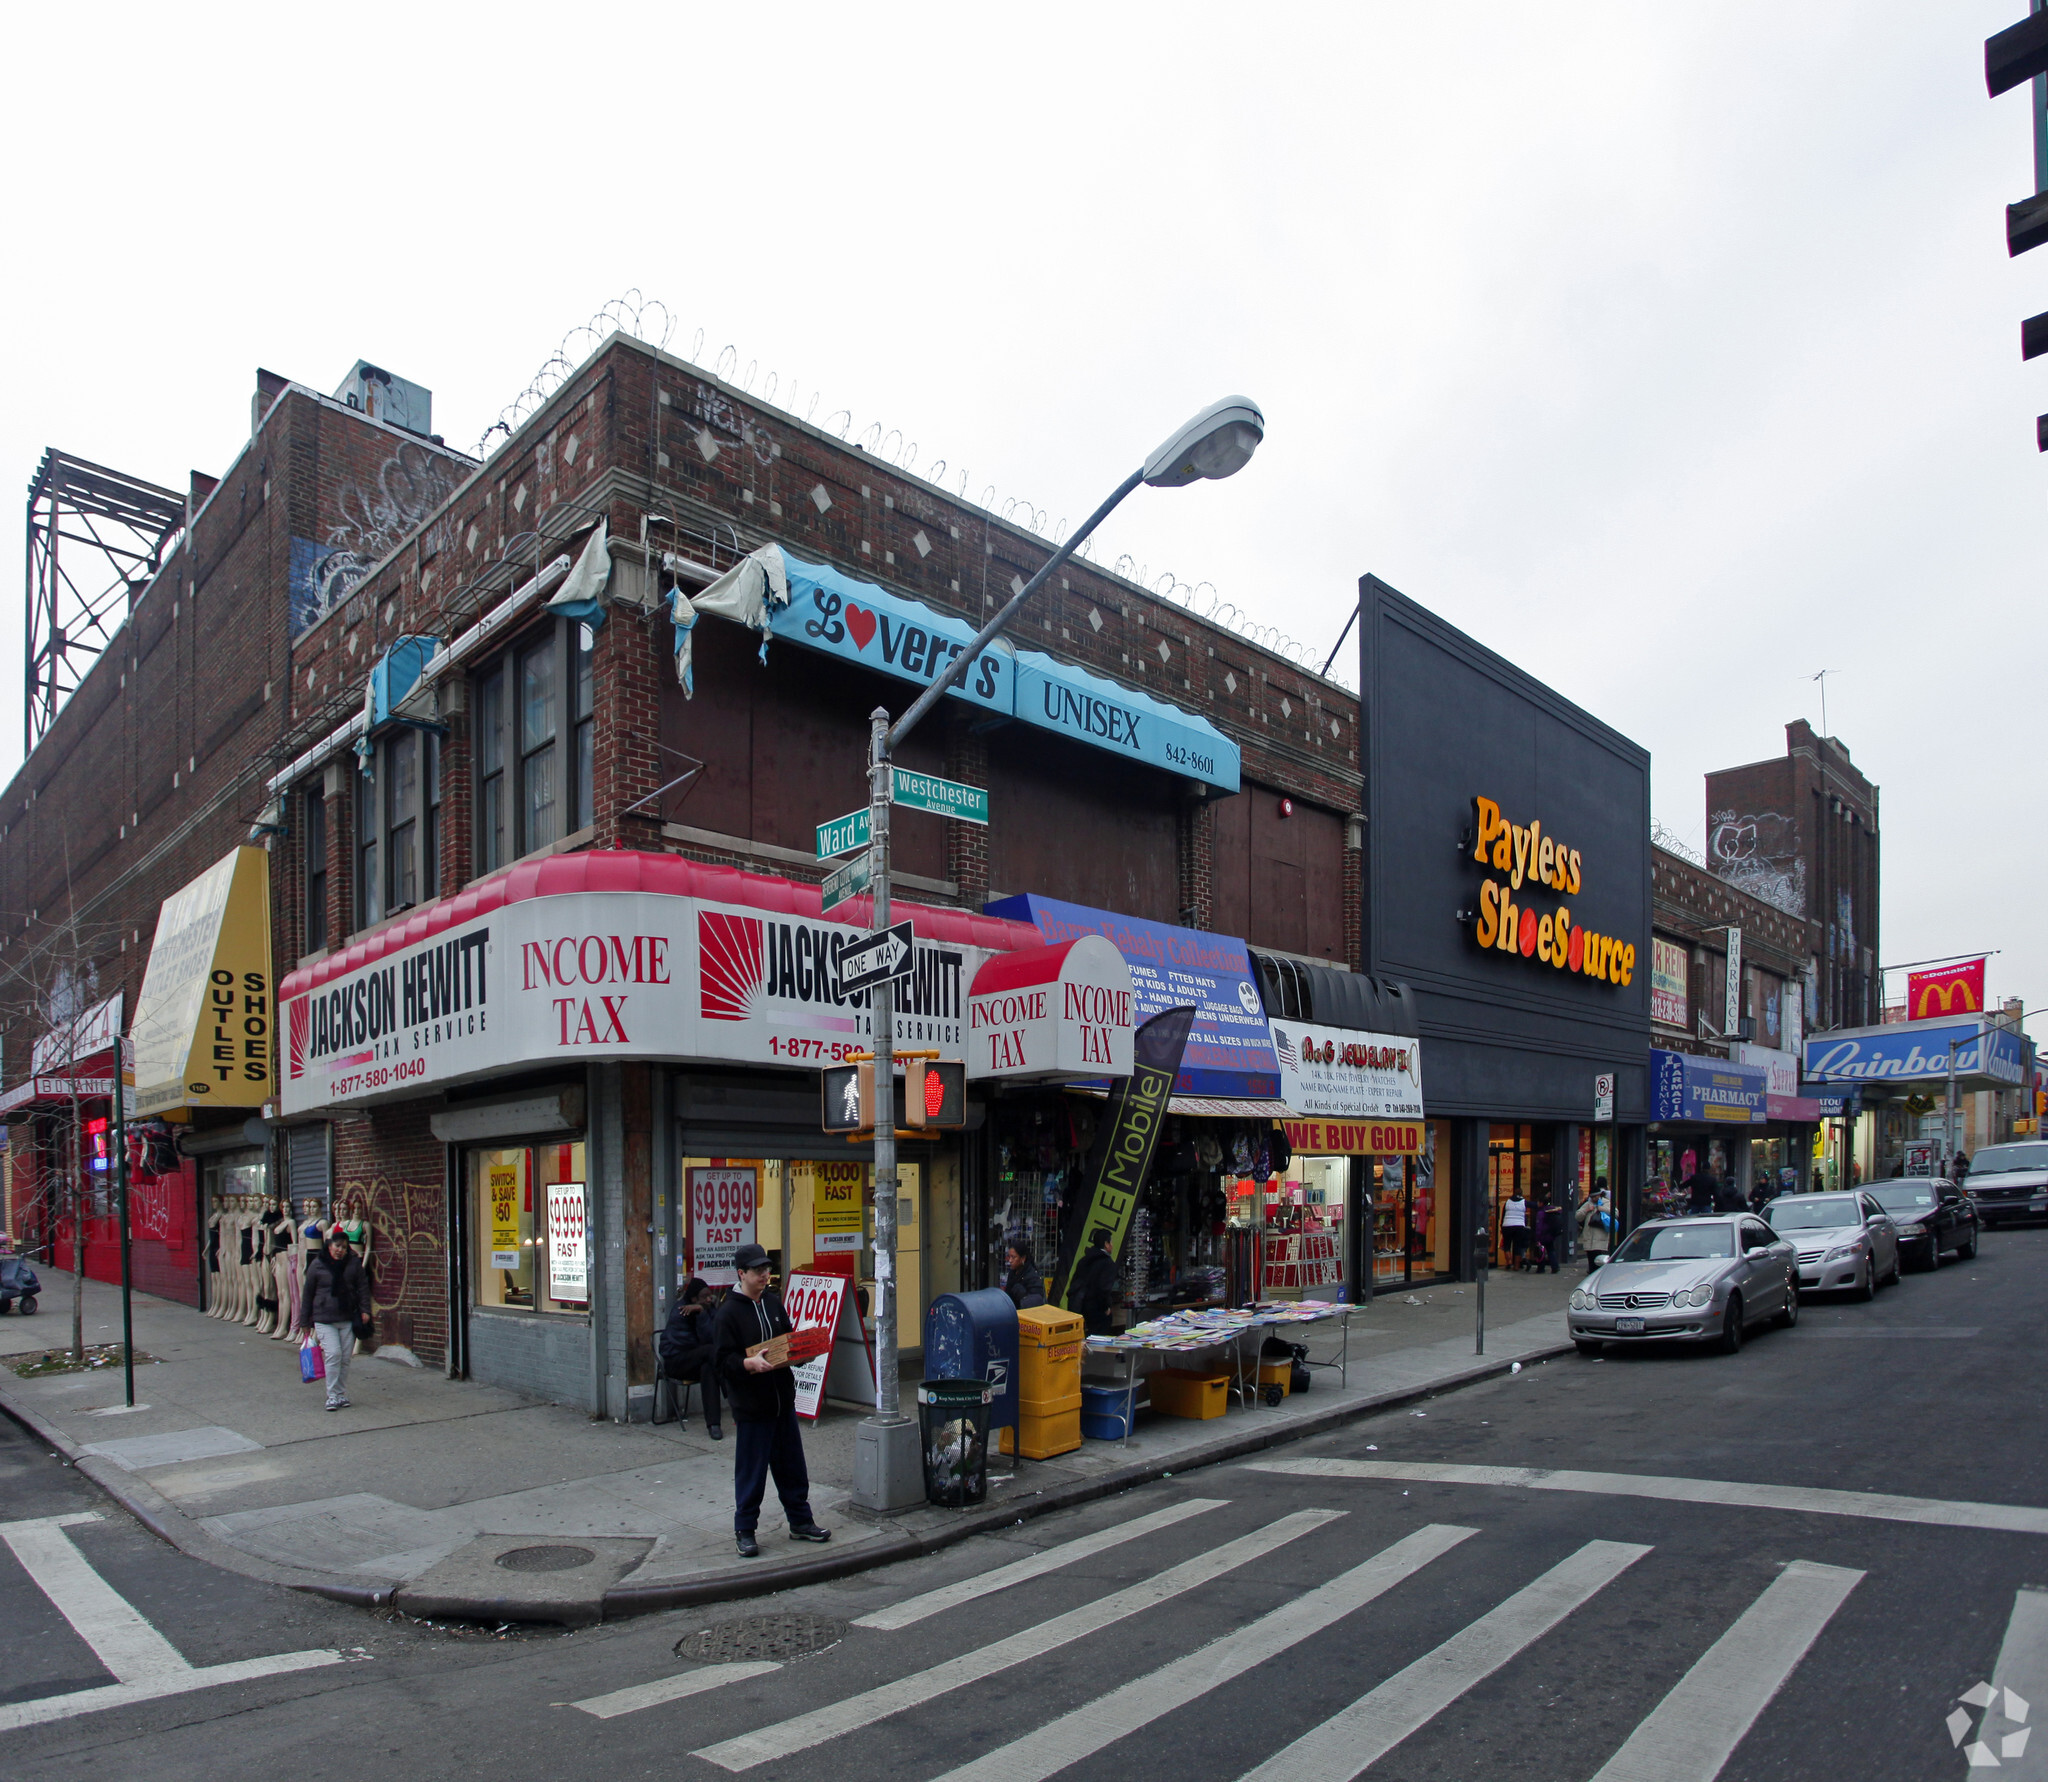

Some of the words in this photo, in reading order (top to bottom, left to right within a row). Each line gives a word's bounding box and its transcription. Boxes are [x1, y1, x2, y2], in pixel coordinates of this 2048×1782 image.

[1043, 680, 1142, 750] UNISEX
[1165, 743, 1214, 776] 842-8601
[898, 772, 981, 809] Westchester
[926, 799, 956, 814] Avenue
[819, 817, 855, 856] Ward
[1474, 795, 1582, 895] Payless
[1476, 879, 1636, 986] ShoeSource
[520, 935, 671, 991] INCOME
[847, 955, 867, 977] ONE
[875, 942, 900, 967] WAY
[1169, 936, 1250, 974] Collection
[1664, 945, 1687, 981] RENT
[767, 922, 874, 1010] JACKS
[892, 947, 963, 1019] EWITT
[1128, 964, 1158, 979] FUMES
[1168, 971, 1194, 985] FTTED
[1195, 976, 1217, 989] HATS
[1728, 931, 1738, 1030] PHARMACY
[1909, 964, 1976, 982] McDonald's
[310, 966, 396, 1059] JACKSON
[402, 927, 489, 1029] HEWITT
[1132, 977, 1145, 988] OR
[1146, 979, 1167, 991] KIDS
[1168, 983, 1175, 993] &
[1177, 985, 1208, 999] ADULTS
[1149, 992, 1173, 1005] HAND
[1174, 997, 1197, 1008] BAGS
[1203, 1001, 1230, 1013] LUGGAGE
[971, 992, 1047, 1029] INCOME
[1064, 982, 1131, 1028] INCOME
[1194, 1010, 1218, 1022] MENS
[1218, 1012, 1265, 1027] UNDERWEAR
[211, 970, 235, 1081] OUTLET
[243, 973, 267, 1081] SHOES
[552, 995, 631, 1046] TAX
[855, 1015, 872, 1036] TA
[897, 1020, 960, 1044] SERVICE
[375, 1037, 400, 1061] TAX
[413, 1011, 486, 1050] SERVICE
[988, 1029, 1026, 1070] TAX
[1080, 1025, 1113, 1065] TAX
[1204, 1034, 1219, 1045] ALL
[1219, 1035, 1241, 1047] SIZES
[1337, 1042, 1396, 1071] JEWELRY
[1807, 1041, 1978, 1082] Rainbow
[330, 1058, 426, 1097] 1-877-580-1040
[1300, 1082, 1317, 1092] NAME
[1350, 1085, 1364, 1096] PLATE
[1335, 1072, 1348, 1082] FINE
[1659, 1064, 1670, 1119] PHARMACY
[1671, 1062, 1683, 1119] FARMACIA
[1304, 1099, 1313, 1109] All
[1314, 1100, 1332, 1111] Kinds
[1332, 1101, 1340, 1111] of
[1340, 1102, 1361, 1114] Special
[1692, 1085, 1760, 1106] PHARMACY
[1107, 1075, 1163, 1187] Mobile
[1284, 1122, 1322, 1149] WE
[1326, 1124, 1367, 1150] BUY
[1370, 1126, 1418, 1151] GOLD
[490, 1172, 515, 1187] SWITCH
[706, 1172, 720, 1180] GET
[722, 1171, 731, 1180] UP
[733, 1171, 742, 1179] TO
[817, 1162, 859, 1184] $1,000
[491, 1188, 497, 1202] &
[498, 1187, 516, 1201] SAVE
[695, 1181, 753, 1227] $9,999
[824, 1186, 853, 1200] FAST
[495, 1202, 511, 1222] $50
[550, 1195, 583, 1240] $9,999
[557, 1243, 578, 1257] FAST
[706, 1228, 742, 1243] FAST
[704, 1260, 730, 1268] JACKSON
[801, 1277, 813, 1286] GET
[814, 1279, 822, 1287] UP
[823, 1279, 832, 1288] TO
[1019, 1322, 1041, 1336] ecialito
[1048, 1346, 1054, 1358] El
[796, 1371, 805, 1379] FOR
[805, 1372, 822, 1381] DETAILS
[807, 1364, 824, 1373] REFUND
[799, 1381, 817, 1392] HEWITT
